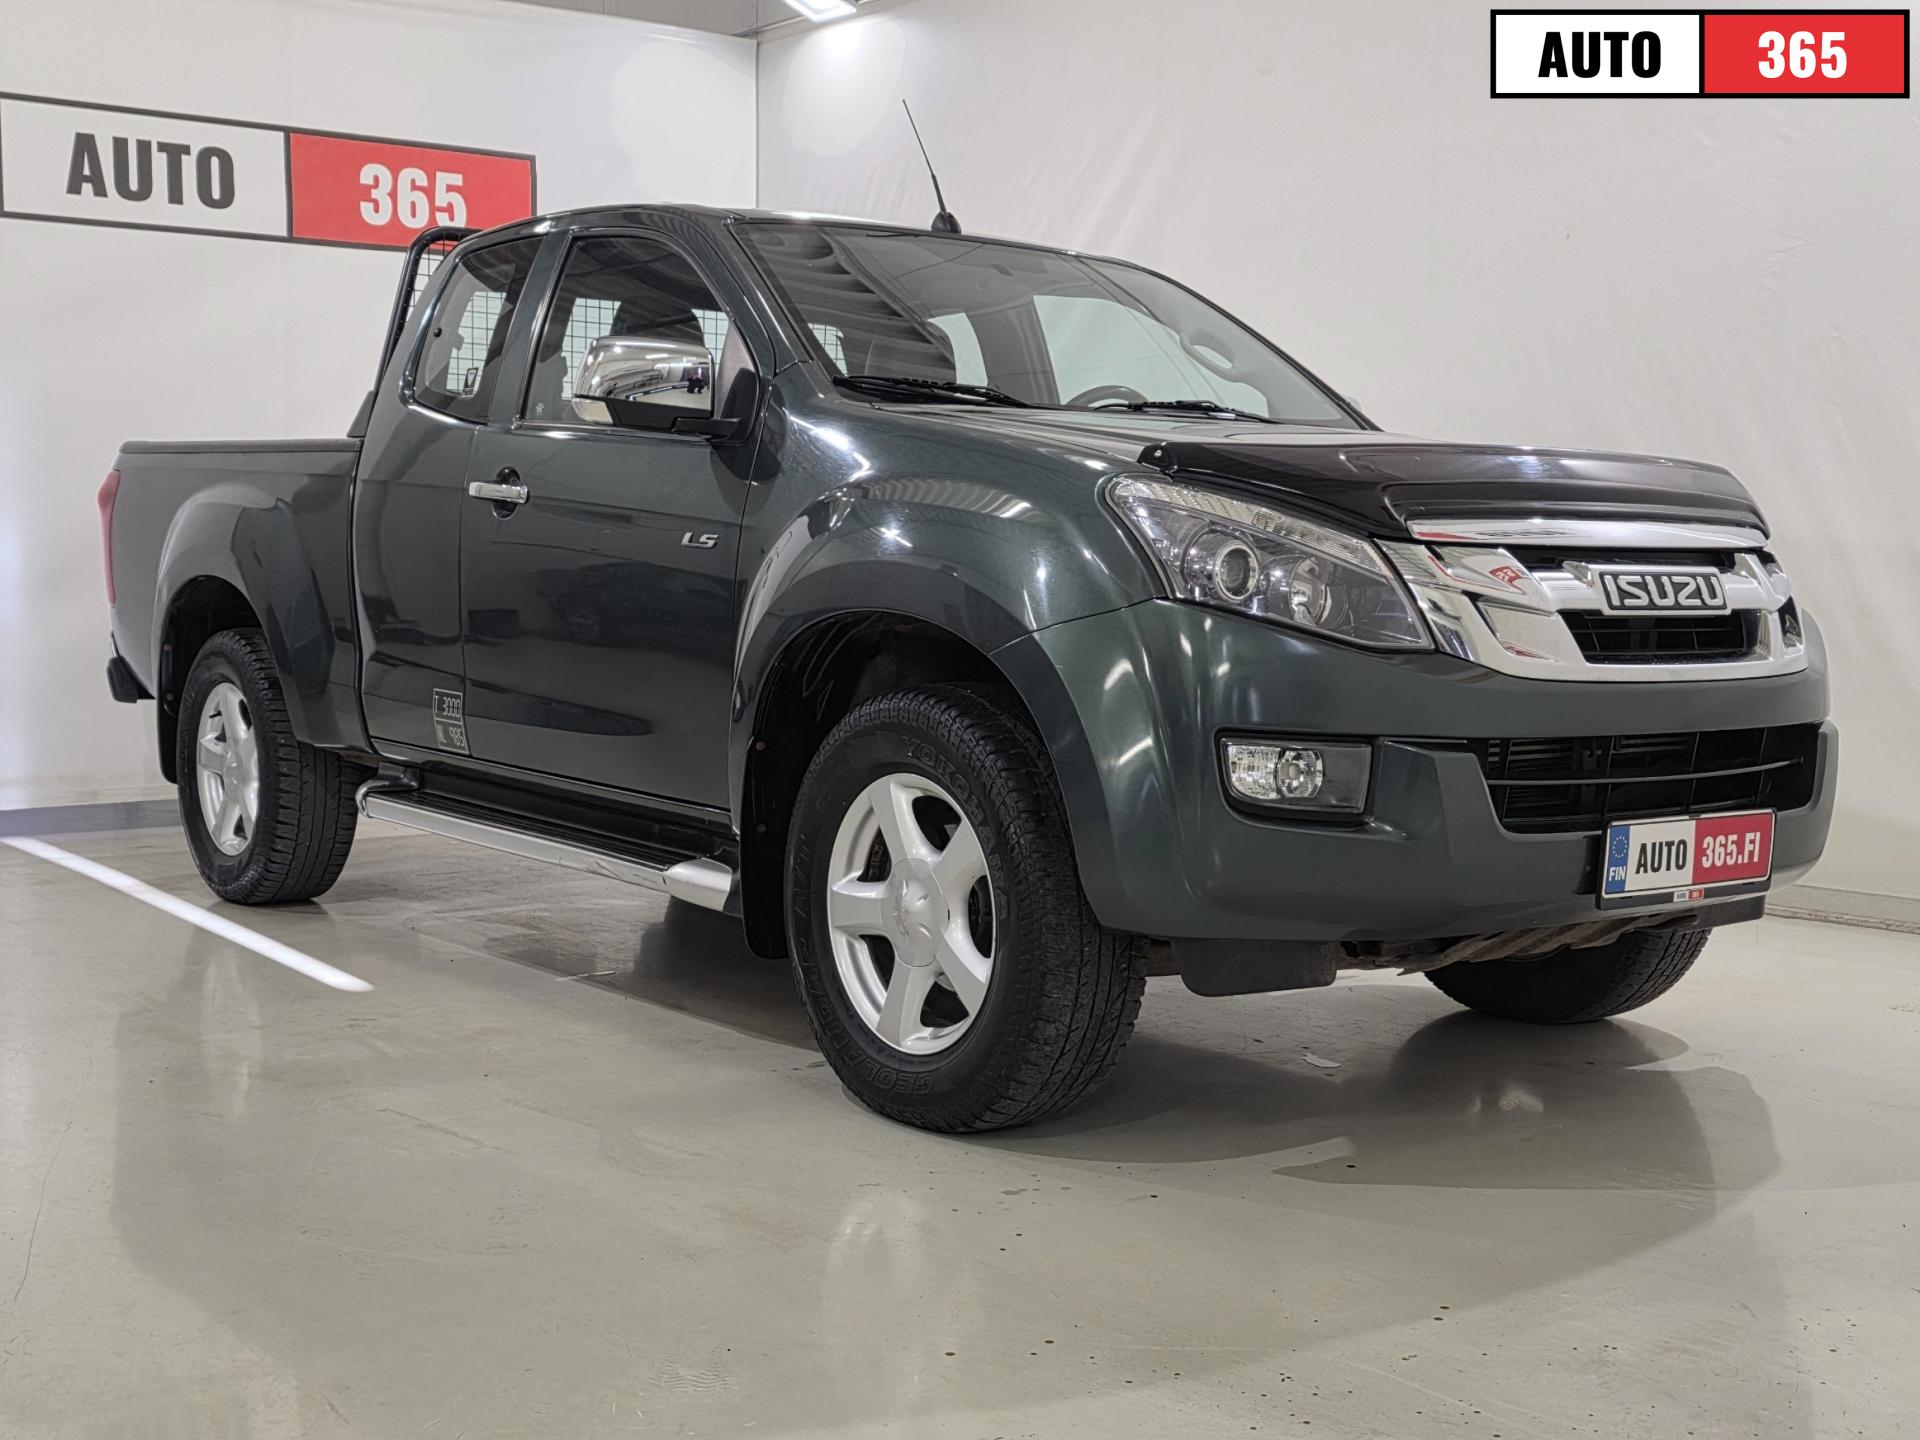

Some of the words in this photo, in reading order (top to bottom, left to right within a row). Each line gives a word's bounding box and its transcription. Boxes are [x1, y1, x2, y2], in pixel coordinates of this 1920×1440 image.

[66, 132, 235, 210] AUTO
[359, 163, 467, 228] 365
[681, 531, 719, 548] LS
[1604, 575, 1724, 606] ISUZU
[1635, 839, 1688, 874] AUTO
[1702, 832, 1761, 868] 365.FI
[1608, 865, 1627, 881] FIN
